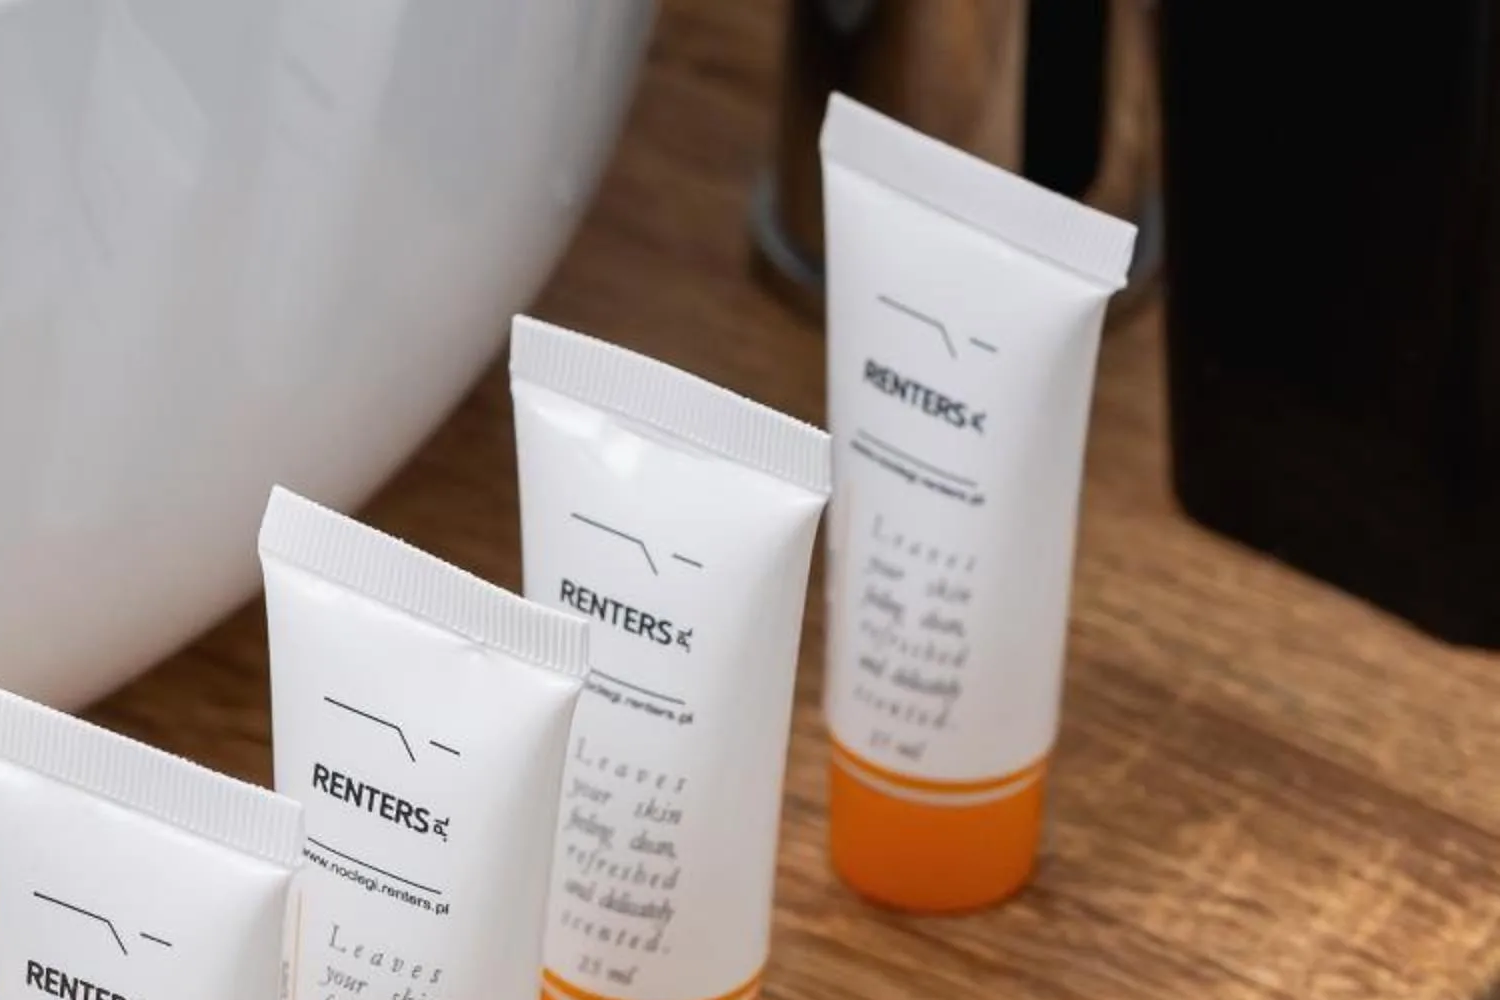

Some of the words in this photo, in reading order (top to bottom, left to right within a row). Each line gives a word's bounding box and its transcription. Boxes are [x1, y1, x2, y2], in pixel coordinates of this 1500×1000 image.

[863, 358, 968, 430] RENTERS
[560, 578, 673, 647] RENTERS
[313, 763, 430, 834] RENTERS
[318, 965, 368, 995] your
[329, 924, 443, 984] Leaves
